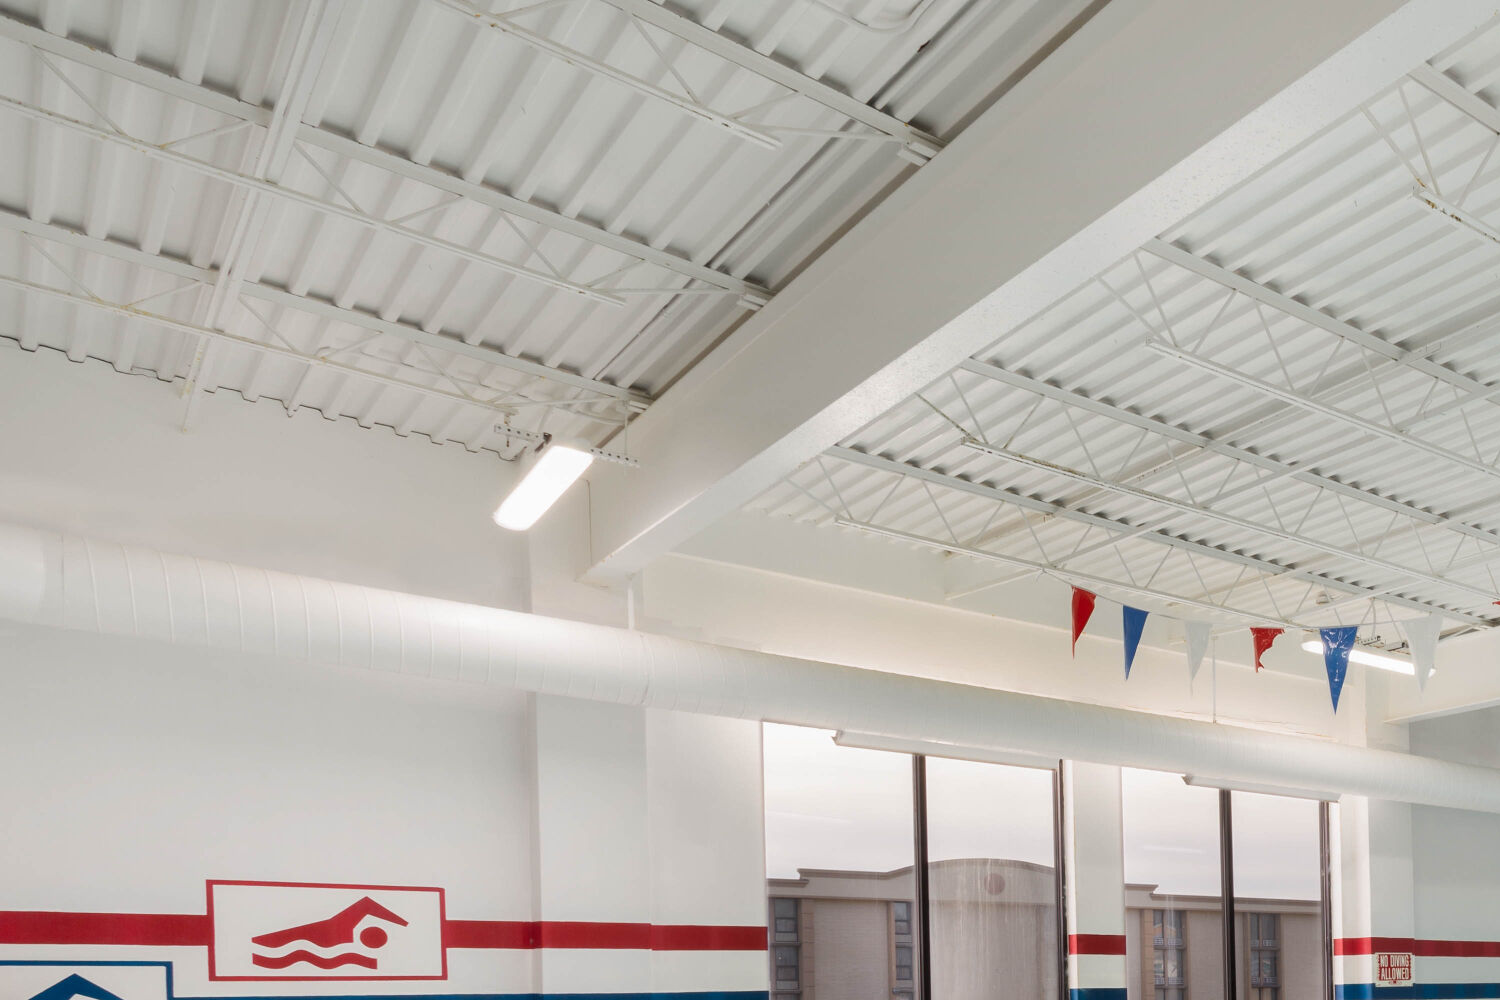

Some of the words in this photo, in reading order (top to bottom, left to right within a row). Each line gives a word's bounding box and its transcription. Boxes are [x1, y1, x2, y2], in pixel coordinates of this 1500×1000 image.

[1380, 954, 1389, 967] NO
[1390, 954, 1410, 967] DIVING
[1381, 967, 1410, 980] ALLOWED
